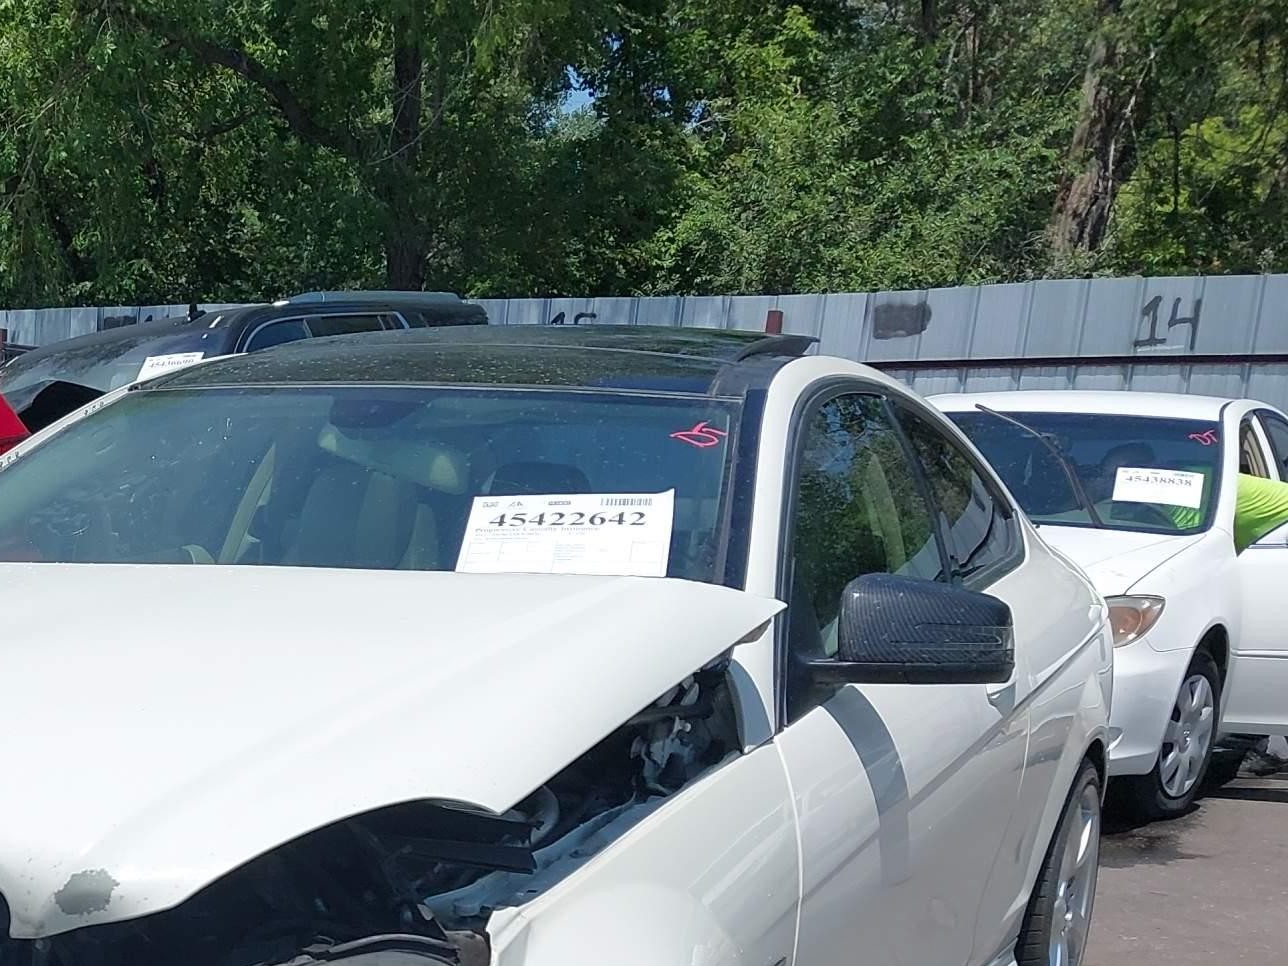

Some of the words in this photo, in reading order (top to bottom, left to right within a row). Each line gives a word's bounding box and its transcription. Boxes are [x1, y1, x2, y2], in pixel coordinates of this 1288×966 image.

[1134, 295, 1202, 351] 14
[1125, 474, 1192, 487] 45438838
[488, 511, 647, 527] 45422642
